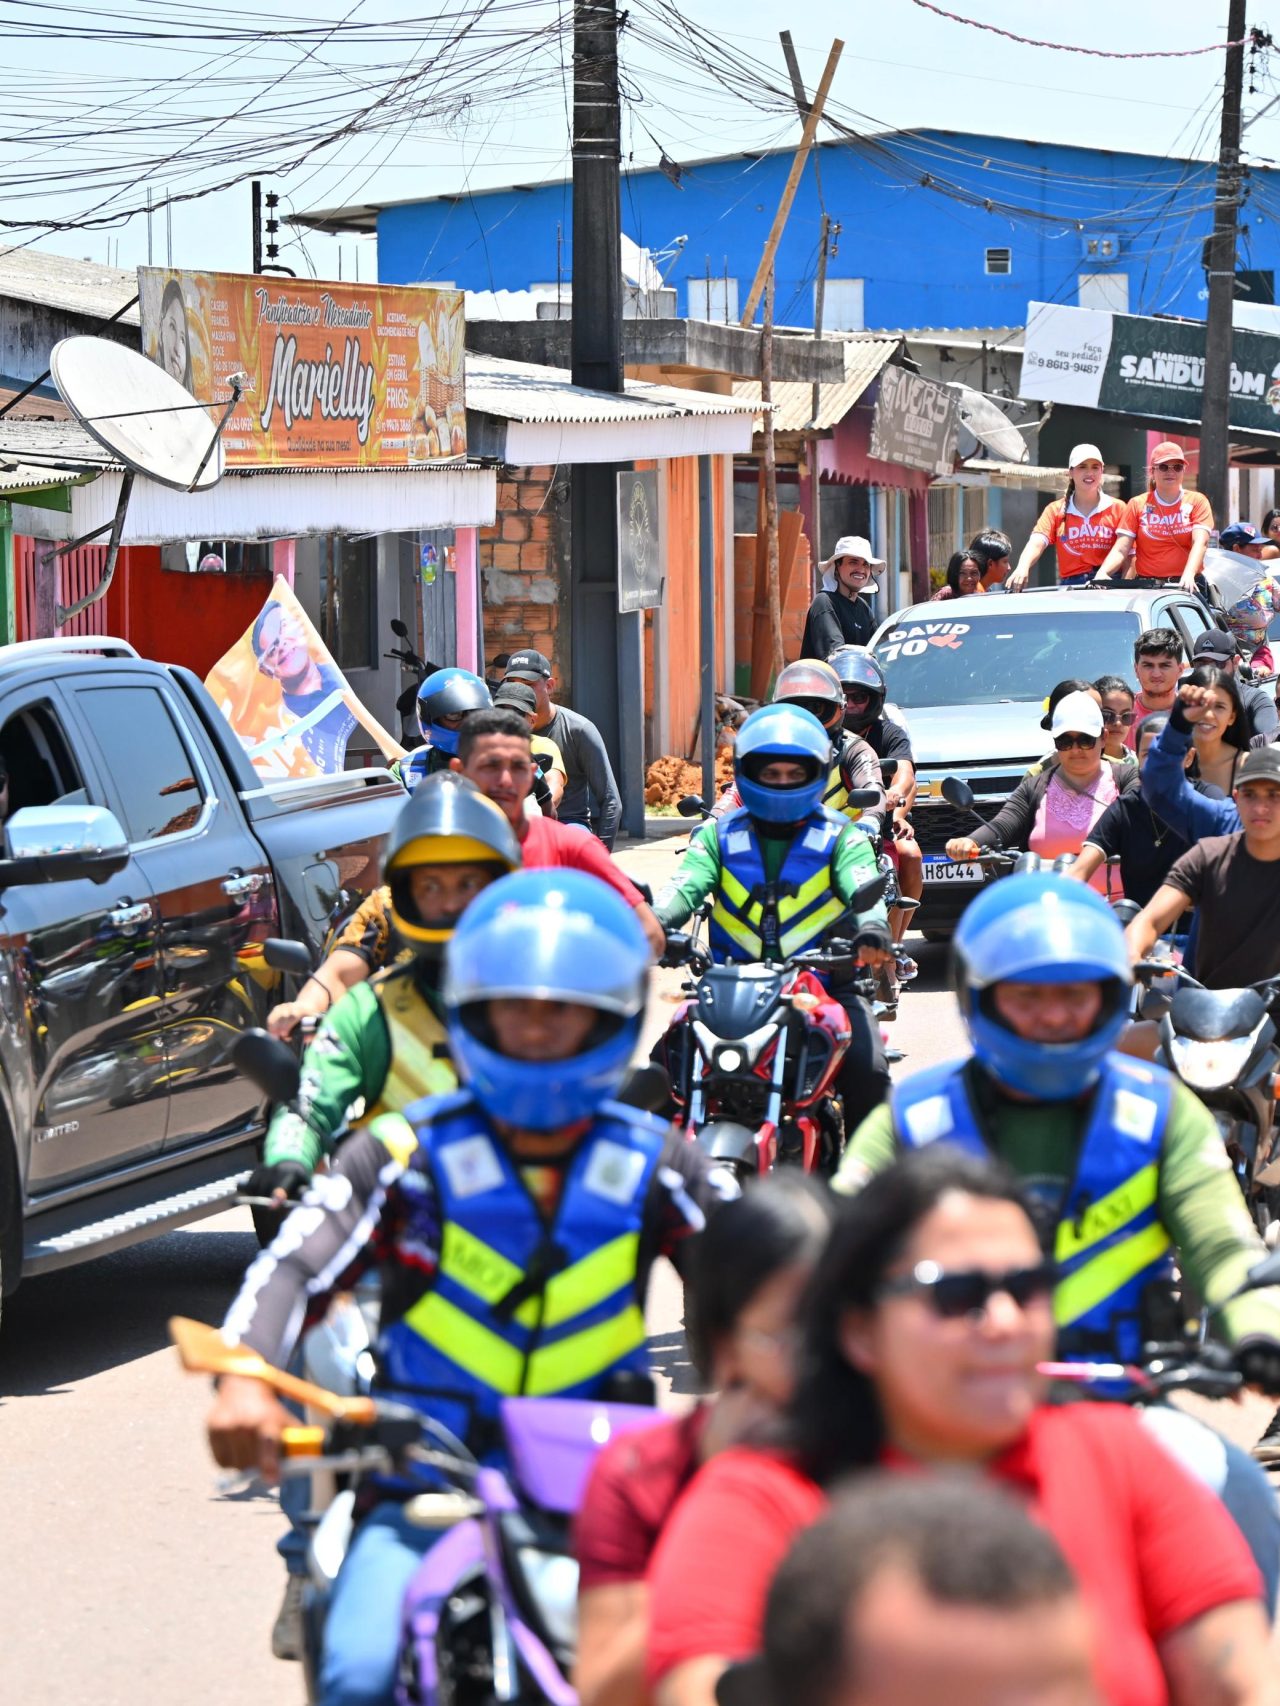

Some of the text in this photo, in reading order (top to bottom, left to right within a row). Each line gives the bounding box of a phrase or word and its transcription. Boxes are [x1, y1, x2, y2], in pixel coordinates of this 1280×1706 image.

[320, 292, 374, 330] Mercadinho
[1038, 358, 1045, 367] 9
[1120, 355, 1266, 396] SANDUOM
[260, 332, 376, 446] Marielly
[386, 387, 409, 409] FRIOS
[1068, 523, 1114, 540] DAVID
[889, 622, 971, 642] DAVID
[878, 639, 928, 662] 70
[920, 862, 975, 881] H8C44
[36, 1120, 80, 1143] LIMITED
